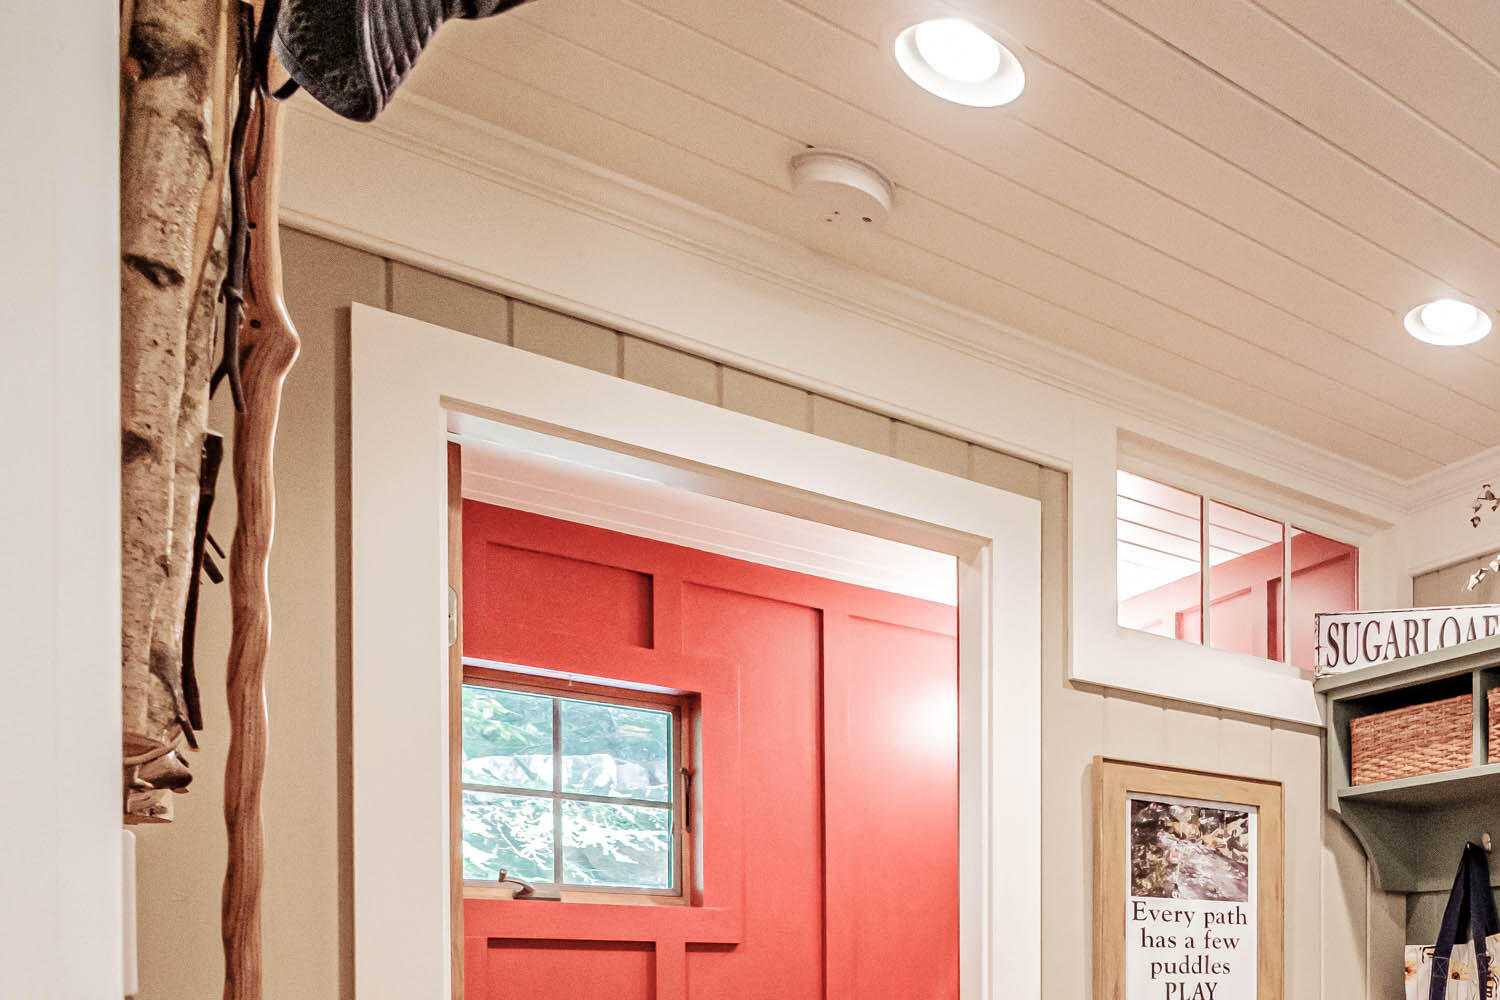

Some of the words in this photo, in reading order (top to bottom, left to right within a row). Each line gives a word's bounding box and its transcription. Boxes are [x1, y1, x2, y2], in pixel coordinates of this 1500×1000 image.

[1131, 899, 1196, 929] Every
[1203, 905, 1248, 929] path
[1141, 927, 1177, 949] has
[1184, 934, 1196, 950] a
[1203, 929, 1240, 950] few
[1150, 954, 1231, 980] puddles
